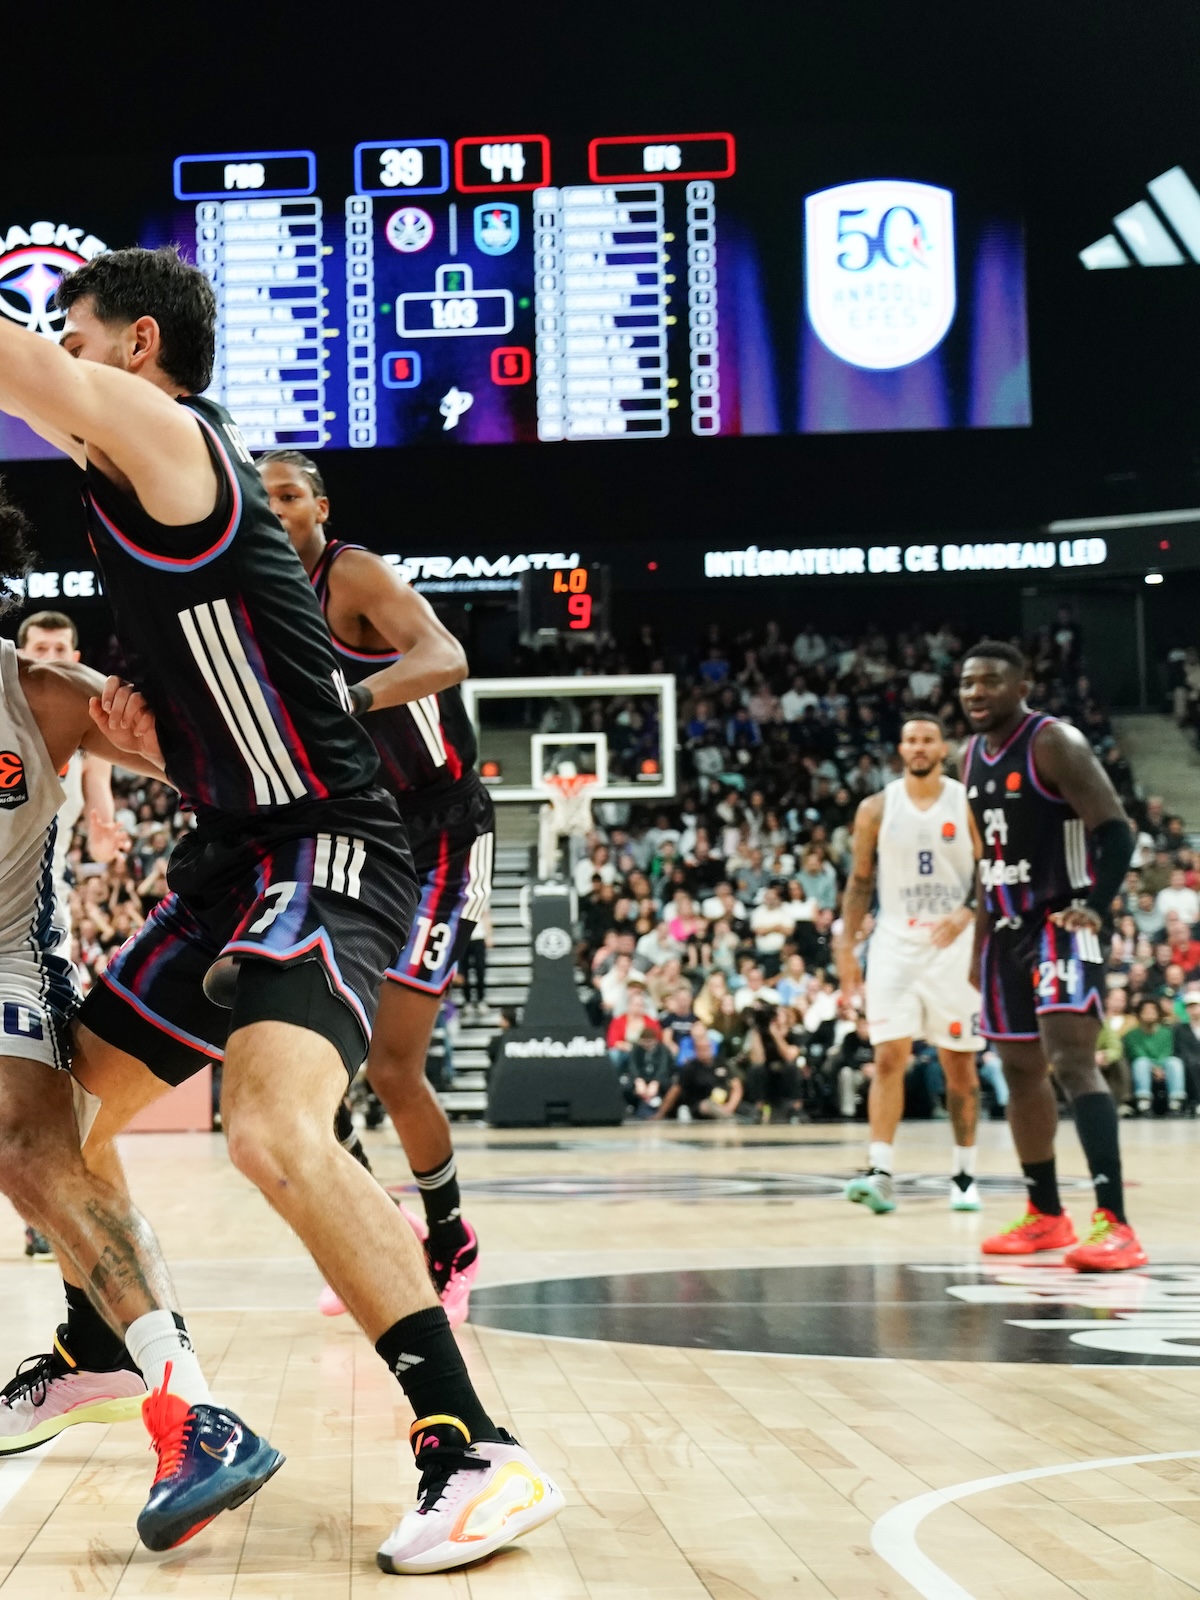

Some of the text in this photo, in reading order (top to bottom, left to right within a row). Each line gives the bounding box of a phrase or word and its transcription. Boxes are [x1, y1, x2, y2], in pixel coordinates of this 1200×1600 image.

[379, 147, 424, 188] 39
[480, 142, 526, 183] 44
[836, 205, 930, 272] 50
[704, 537, 1108, 578] INTÉGRATEUR DE CE BANDEAU LED
[27, 571, 60, 598] DE
[62, 570, 95, 597] CE
[567, 593, 593, 630] 9
[918, 851, 933, 875] 8
[248, 881, 298, 934] 7
[409, 916, 452, 971] 13
[1038, 957, 1079, 996] 24
